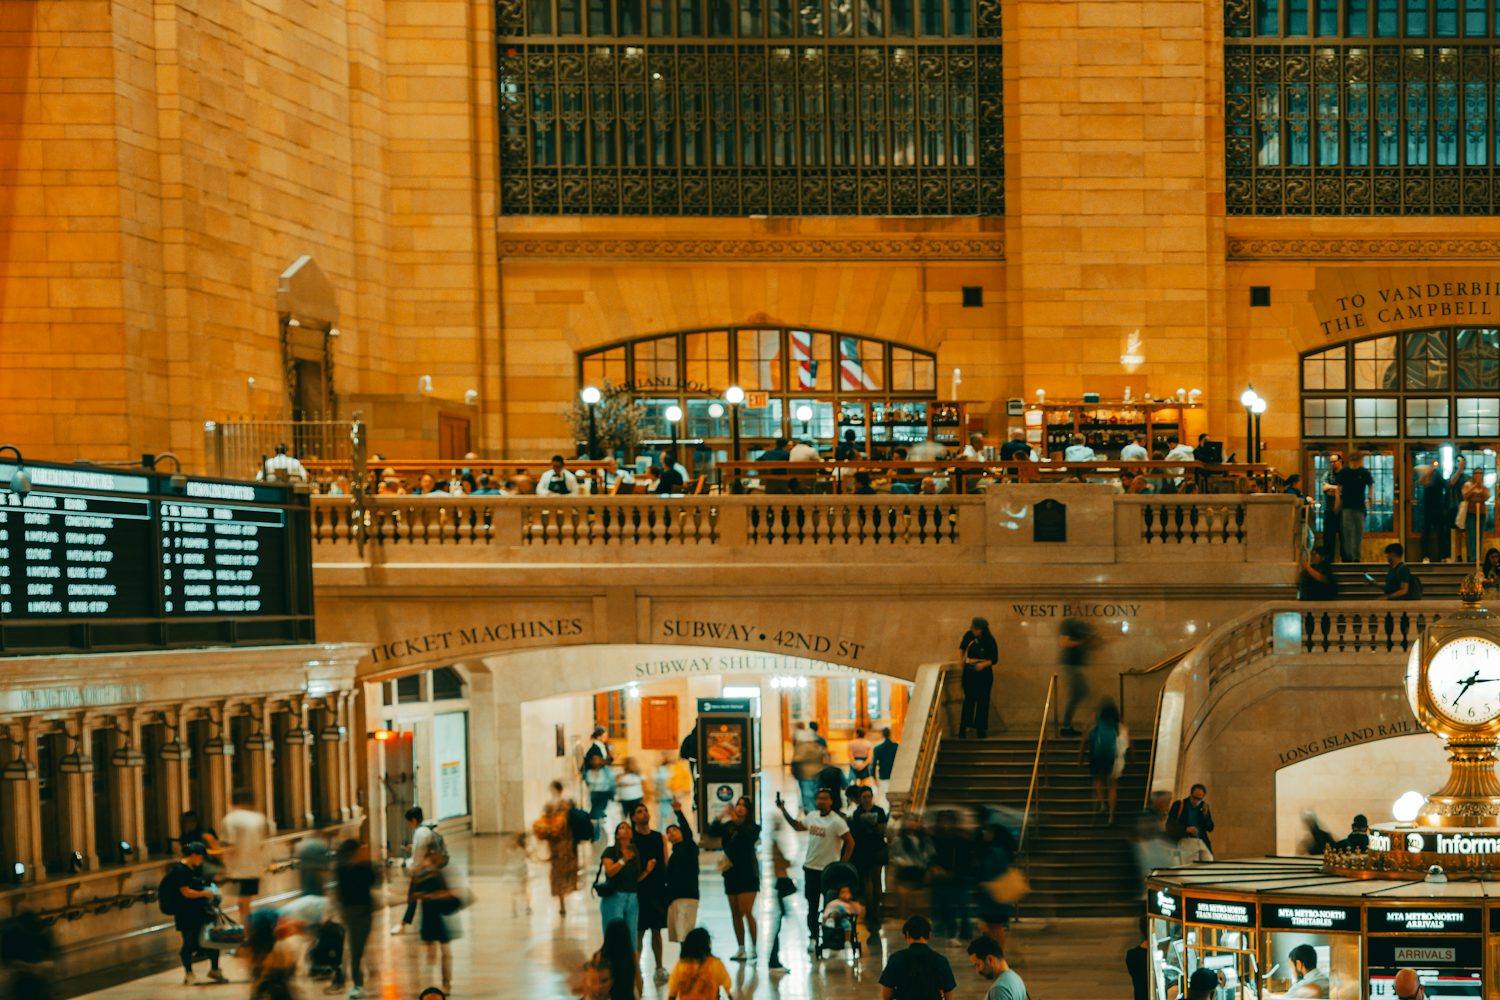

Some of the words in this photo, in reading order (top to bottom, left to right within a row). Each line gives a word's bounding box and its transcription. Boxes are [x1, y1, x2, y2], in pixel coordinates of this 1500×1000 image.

[1337, 293, 1365, 311] TO
[1320, 313, 1365, 336] THE
[1378, 301, 1491, 323] CAMPBELL
[1013, 604, 1058, 617] WEST
[1063, 604, 1141, 617] BALCONY
[371, 631, 452, 663] TICKET
[459, 618, 583, 646] MACHINES
[663, 620, 756, 642] SUBWAY
[773, 630, 831, 653] 42ND
[836, 640, 865, 660] ST
[1466, 645, 1476, 655] 12
[635, 657, 712, 677] SUBWAY
[720, 655, 803, 670] SHUTTLE
[1441, 693, 1447, 704] 8
[1468, 706, 1475, 717] 6
[1279, 741, 1319, 764] LONG
[1322, 727, 1374, 749] ISLAND
[1378, 721, 1412, 736] RAIL
[1386, 911, 1404, 921] MTA
[1405, 911, 1464, 921] METRO-NORTH
[1405, 920, 1445, 929] ARRIVALS
[1398, 949, 1453, 960] ARRIVALS
